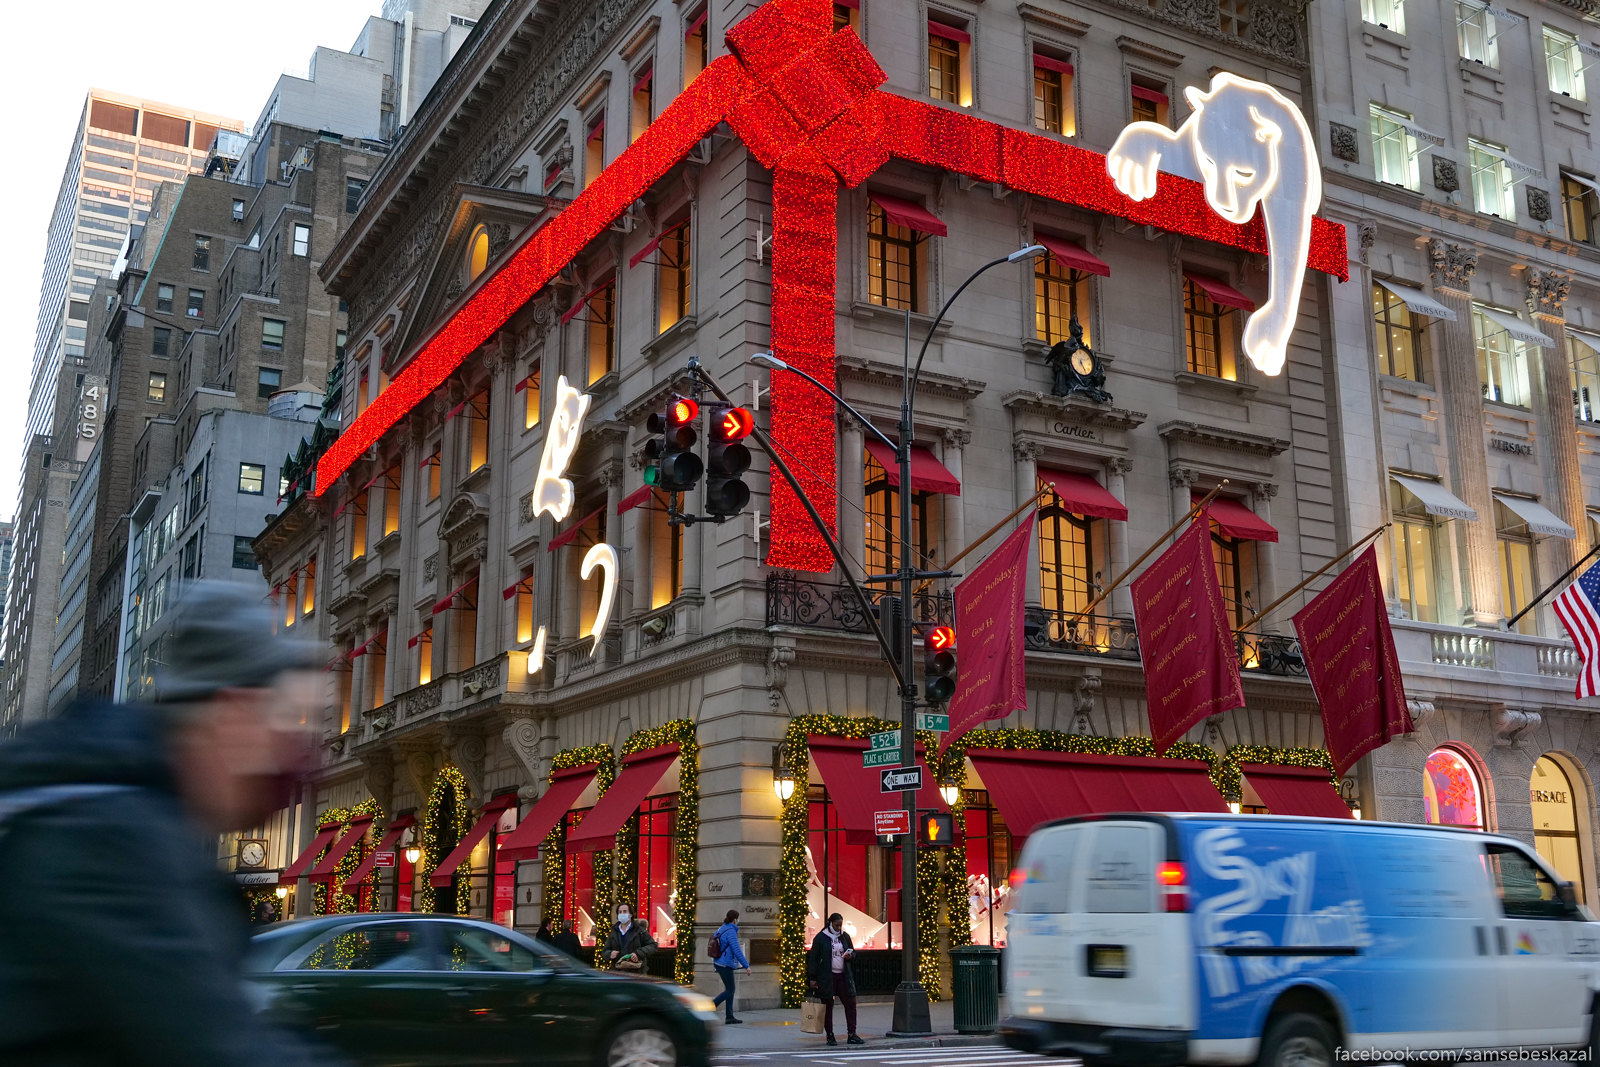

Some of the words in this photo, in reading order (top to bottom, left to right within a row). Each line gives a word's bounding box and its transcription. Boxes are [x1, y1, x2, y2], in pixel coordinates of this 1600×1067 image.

[1408, 127, 1441, 145] VERSACE
[1414, 305, 1448, 317] VERSACE
[1516, 332, 1547, 344] VERSACE
[82, 386, 99, 438] 485
[1054, 422, 1095, 439] Cartier
[1491, 438, 1533, 456] VERSACE
[1434, 505, 1468, 518] VERSACE
[1537, 525, 1568, 536] VERSACE
[1145, 587, 1164, 610] Happy
[1315, 623, 1336, 645] Happy
[1336, 593, 1365, 622] Holidays
[1161, 686, 1181, 706] Bones
[927, 716, 935, 729] 5
[871, 737, 877, 749] E
[880, 735, 890, 747] 52
[864, 754, 877, 764] PLACE
[883, 751, 900, 762] CARTIER
[887, 775, 899, 785] ONE
[903, 774, 916, 784] WAY
[1530, 790, 1568, 803] ERSACE
[243, 874, 271, 885] Cartier
